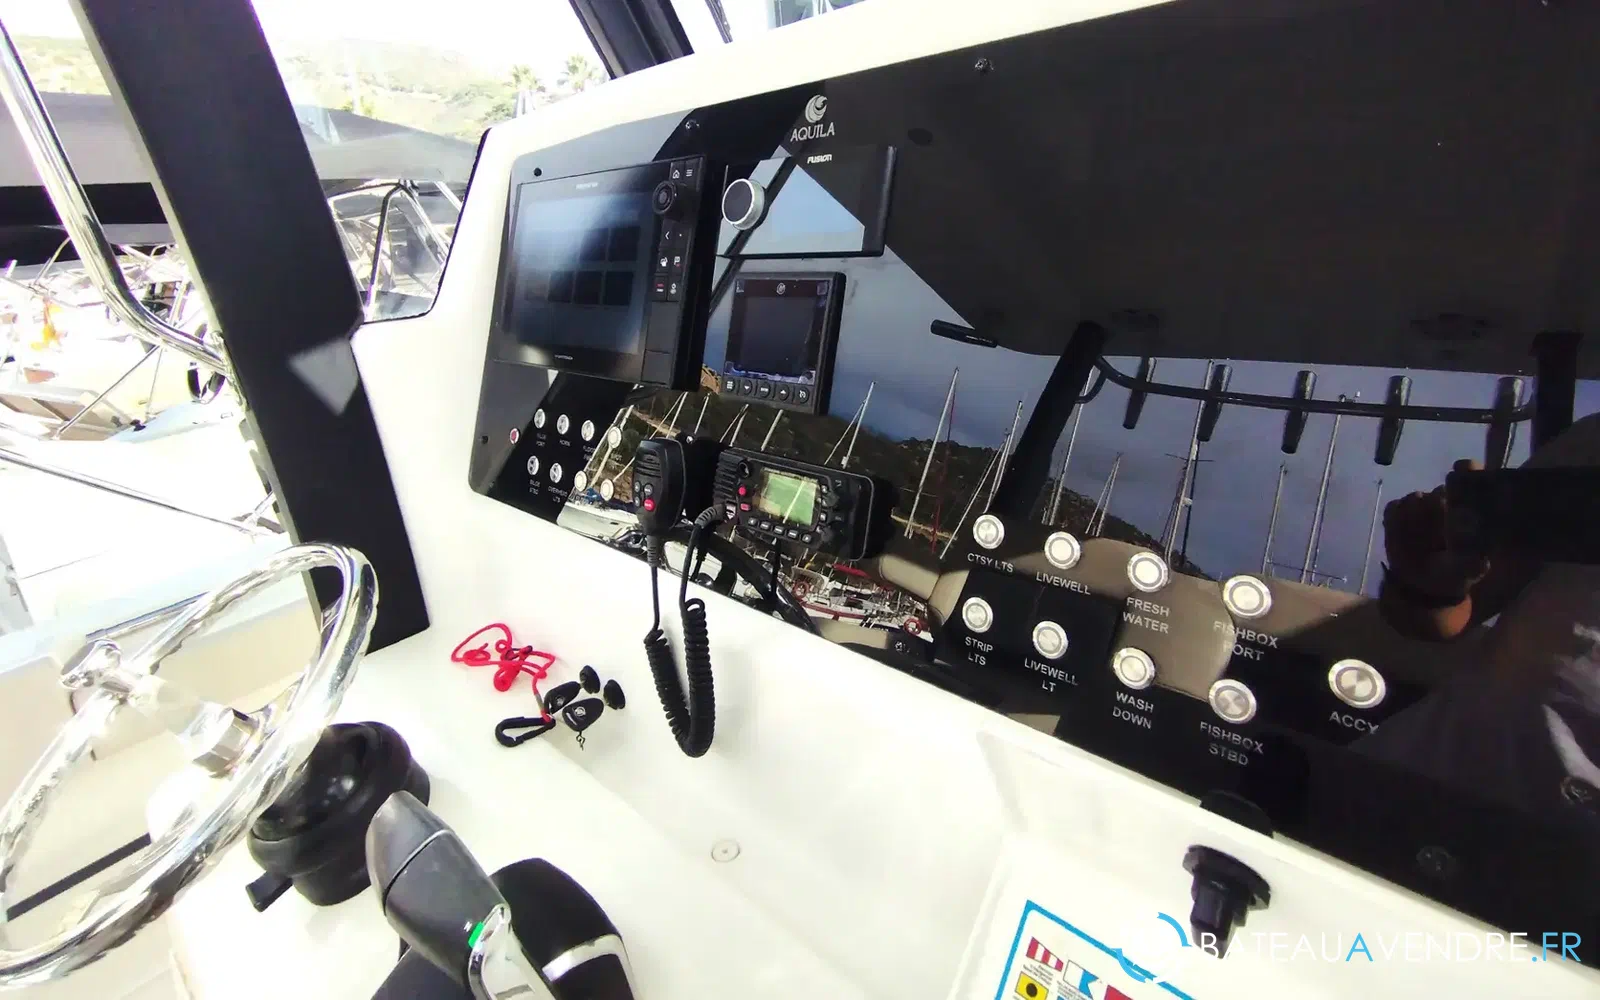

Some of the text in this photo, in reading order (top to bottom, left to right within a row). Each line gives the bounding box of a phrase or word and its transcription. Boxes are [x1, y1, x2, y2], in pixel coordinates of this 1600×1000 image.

[790, 122, 835, 142] AQUILA
[807, 154, 833, 164] FUSION
[967, 553, 1014, 573] CTSY LTS
[1036, 572, 1091, 595] LIVEWELL
[1126, 597, 1170, 617] FRESH
[1122, 611, 1169, 634] WATER
[965, 636, 993, 653] STRIP
[1213, 620, 1278, 649] FISHBOX
[968, 652, 986, 666] LTS
[1024, 658, 1078, 686] LIVEWELL
[1042, 680, 1057, 692] LT
[1116, 691, 1154, 713] WASH
[1112, 707, 1152, 729] DOWN
[1329, 711, 1379, 736] ACCY
[1200, 721, 1264, 754] FISHBOX
[1209, 743, 1249, 766] STBD
